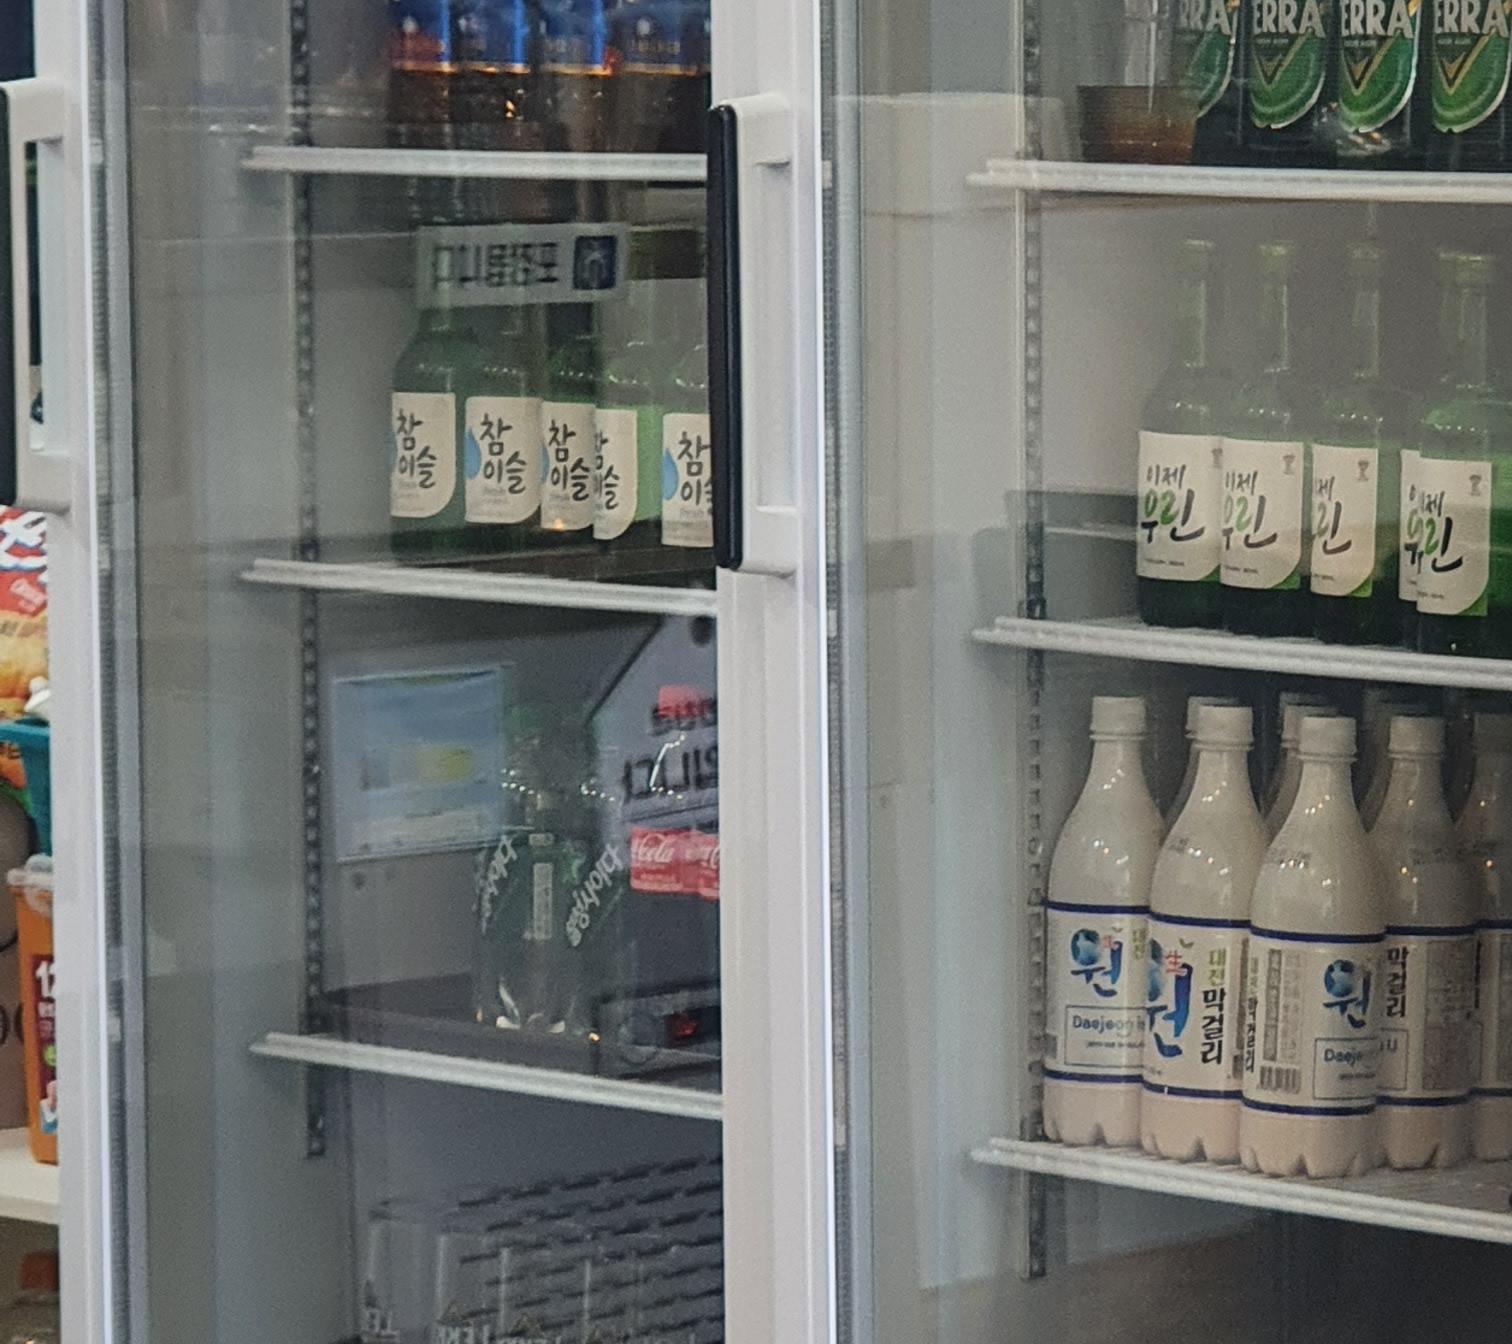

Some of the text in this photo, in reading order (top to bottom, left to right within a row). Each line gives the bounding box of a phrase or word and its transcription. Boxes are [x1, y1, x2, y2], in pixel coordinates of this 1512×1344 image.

[479, 412, 528, 495] 참이슬
[549, 418, 591, 502] 참이슬
[1386, 945, 1409, 1019] 막걸리
[1202, 987, 1227, 1066] 막걸리
